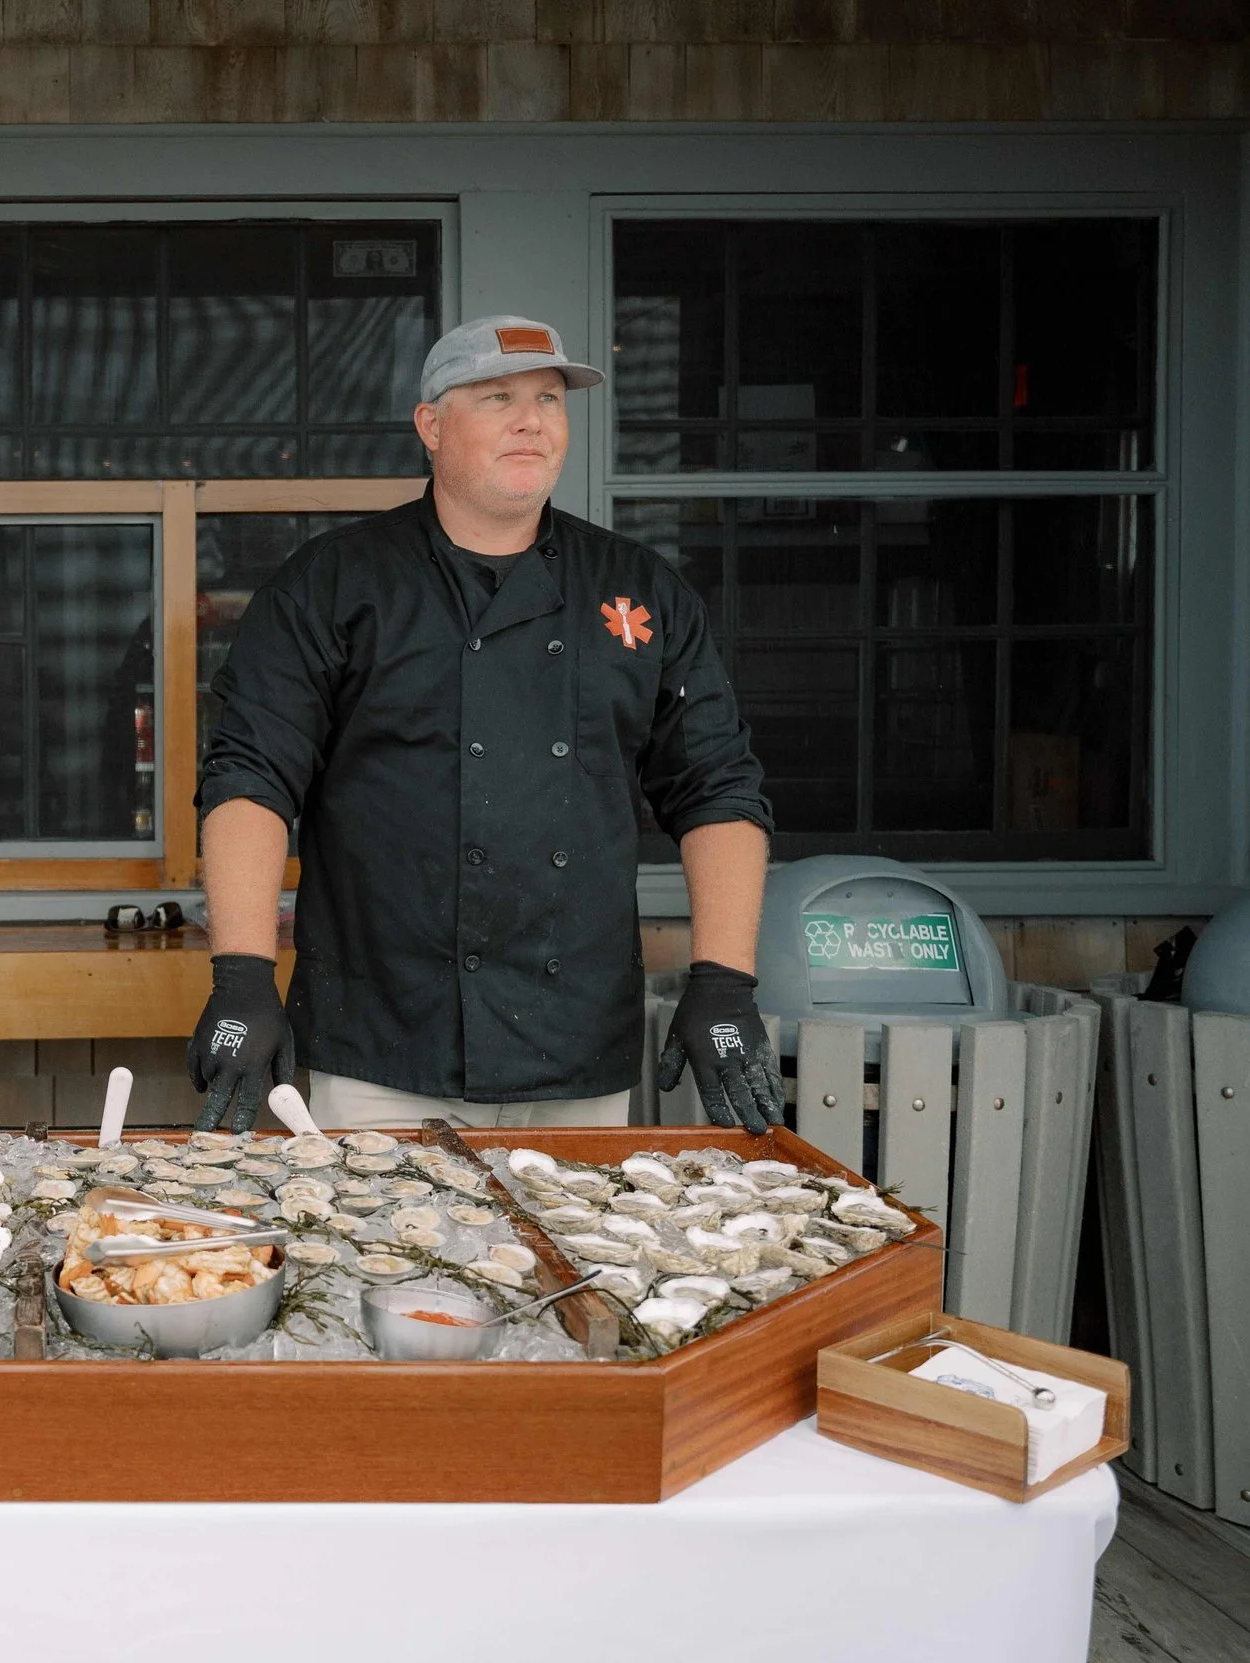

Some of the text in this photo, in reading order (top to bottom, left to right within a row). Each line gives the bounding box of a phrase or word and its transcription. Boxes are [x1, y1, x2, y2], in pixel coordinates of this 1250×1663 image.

[843, 922, 949, 941] RCYCLABLE
[848, 941, 949, 960] WAST ONLY
[212, 1030, 244, 1049] TECH
[712, 1036, 743, 1049] TECH
[232, 1048, 237, 1057] L
